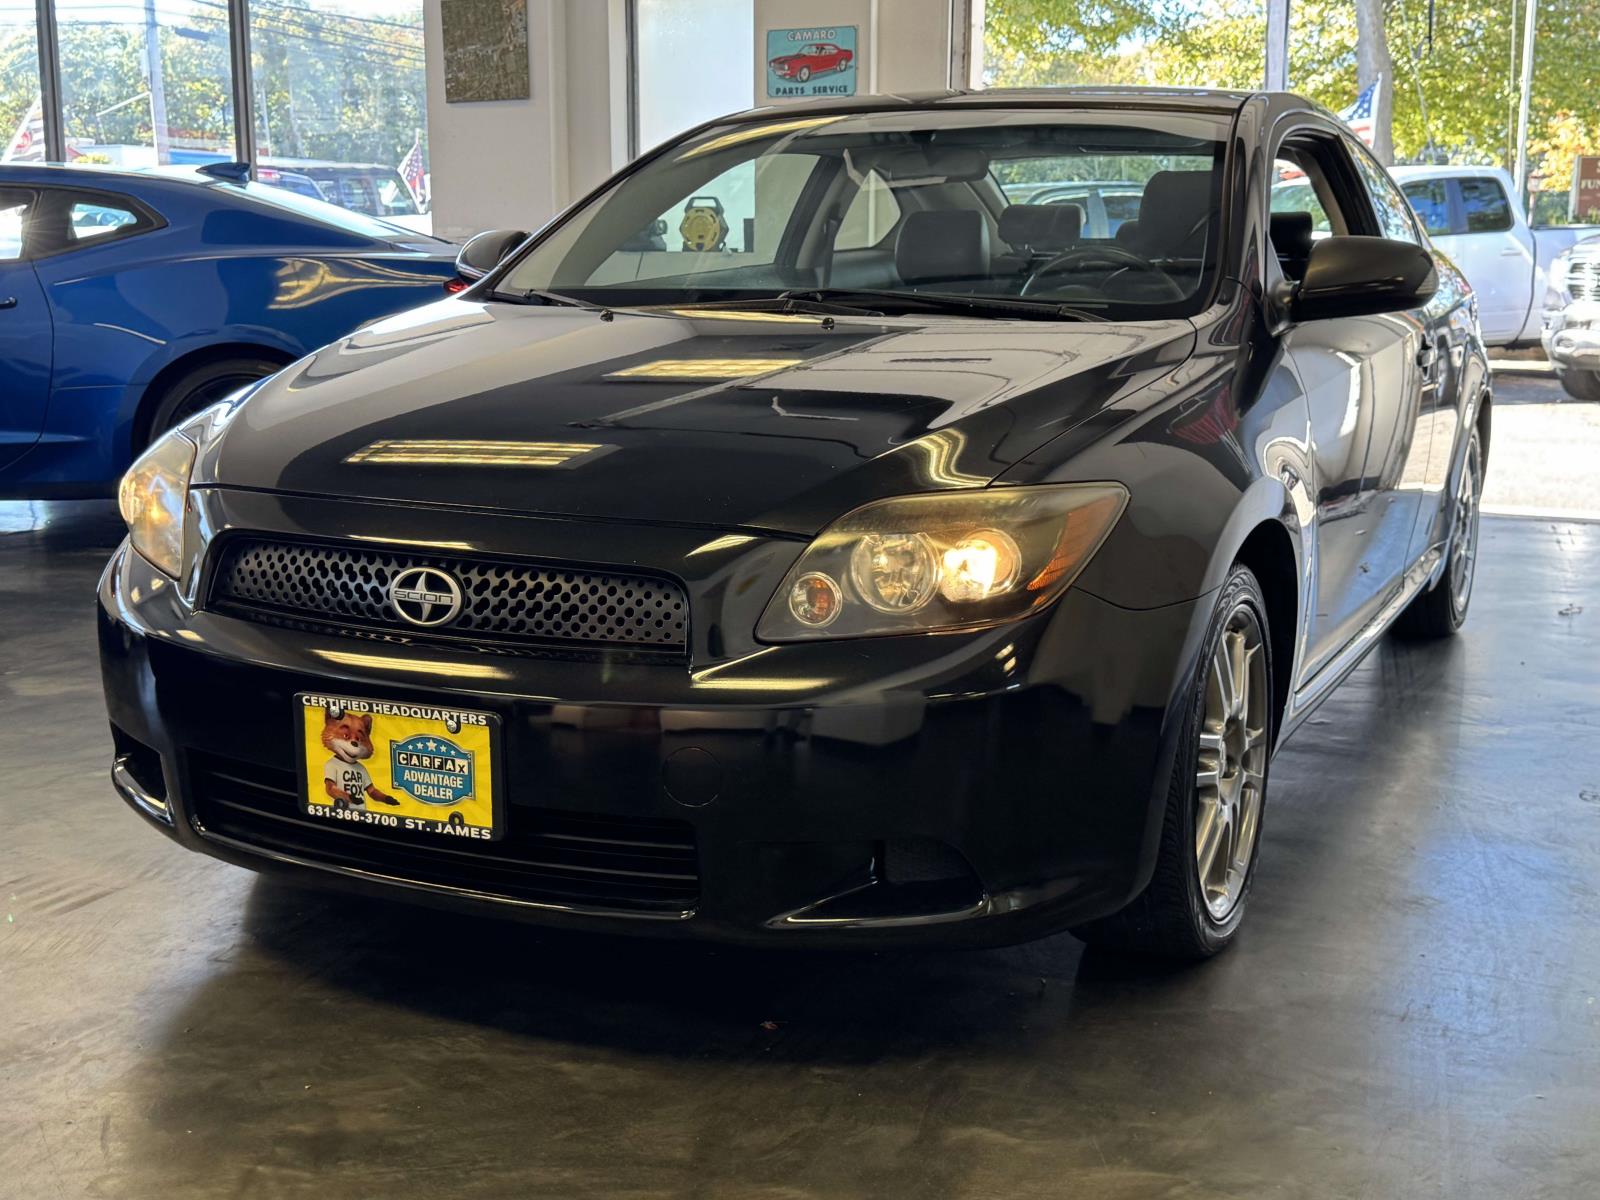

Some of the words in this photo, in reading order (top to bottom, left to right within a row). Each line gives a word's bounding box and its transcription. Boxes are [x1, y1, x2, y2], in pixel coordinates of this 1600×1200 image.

[788, 30, 836, 41] CAMARO
[775, 87, 805, 95] PARTS
[812, 85, 848, 94] SERVICE
[394, 589, 454, 604] SCION
[302, 696, 369, 712] CERTIFIED
[373, 703, 487, 725] HEADQUARTERS
[399, 753, 467, 773] CARFAX
[342, 770, 362, 782] CAR
[404, 770, 463, 788] ADVANTAGE
[343, 783, 364, 798] FOX
[413, 784, 453, 800] DEALER
[307, 805, 398, 827] 631-366-3700
[405, 819, 430, 831] ST.
[435, 822, 491, 839] JAMES
